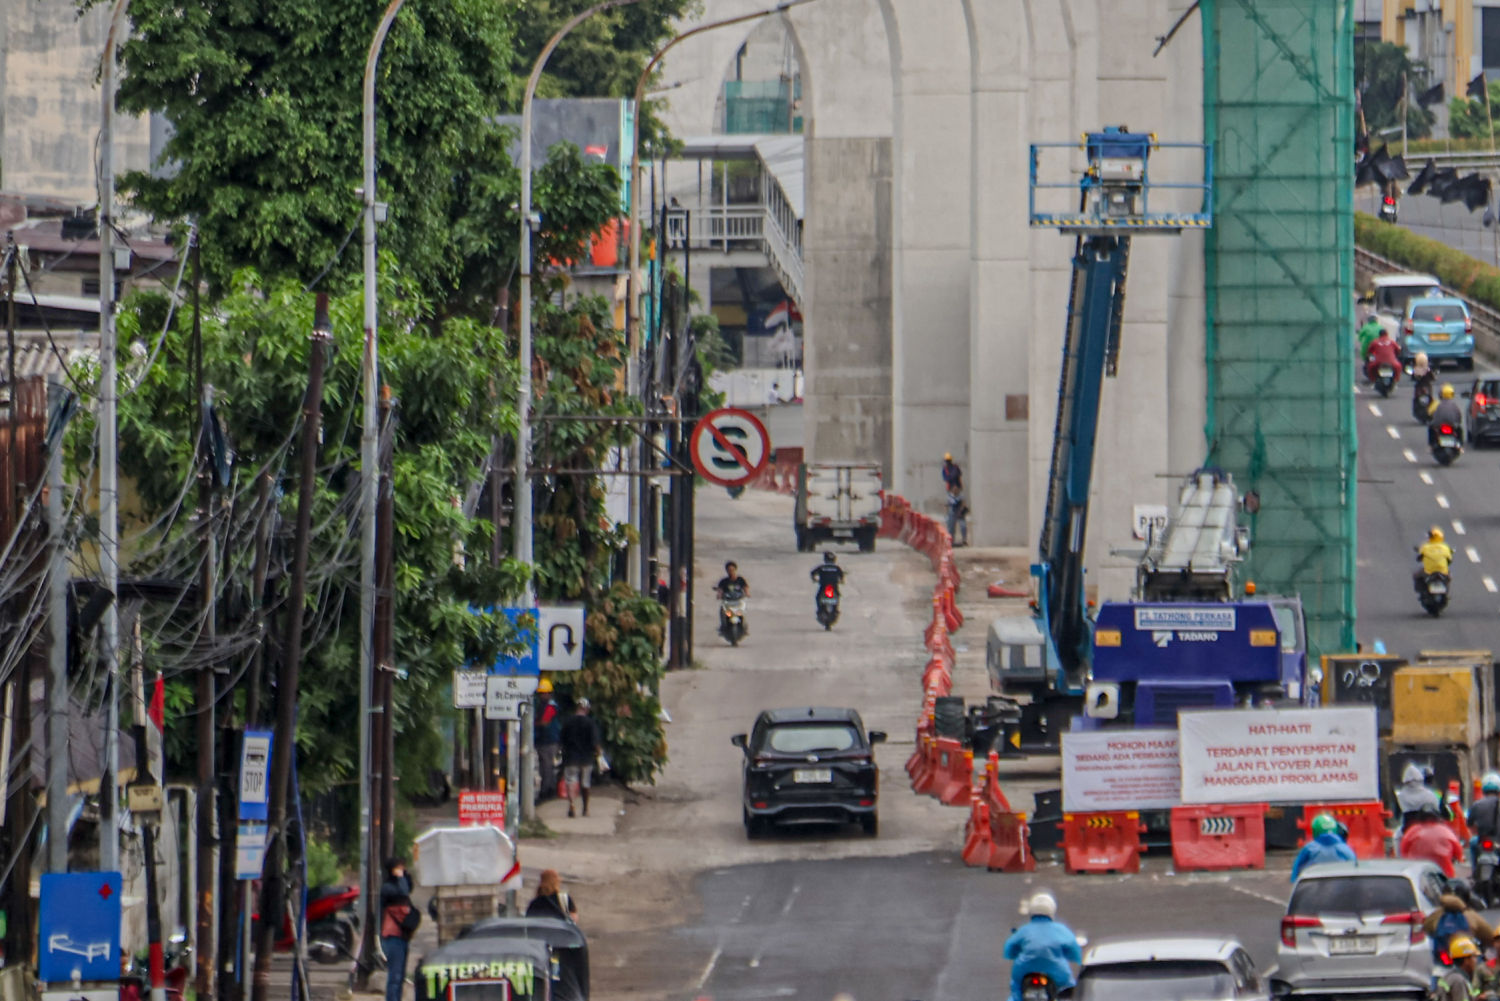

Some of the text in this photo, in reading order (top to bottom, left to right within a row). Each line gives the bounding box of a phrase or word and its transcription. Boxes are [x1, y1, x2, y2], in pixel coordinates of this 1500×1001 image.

[712, 426, 748, 470] S
[1178, 631, 1218, 642] TADANO
[1107, 741, 1146, 751] MOHON
[1206, 743, 1356, 759] TERDAPAT PENYEMPITAN
[1213, 757, 1349, 773] JALAN FLYOVER ARAH
[244, 772, 264, 793] STOP
[1203, 771, 1359, 787] MANGGARAI PROKLAMASI
